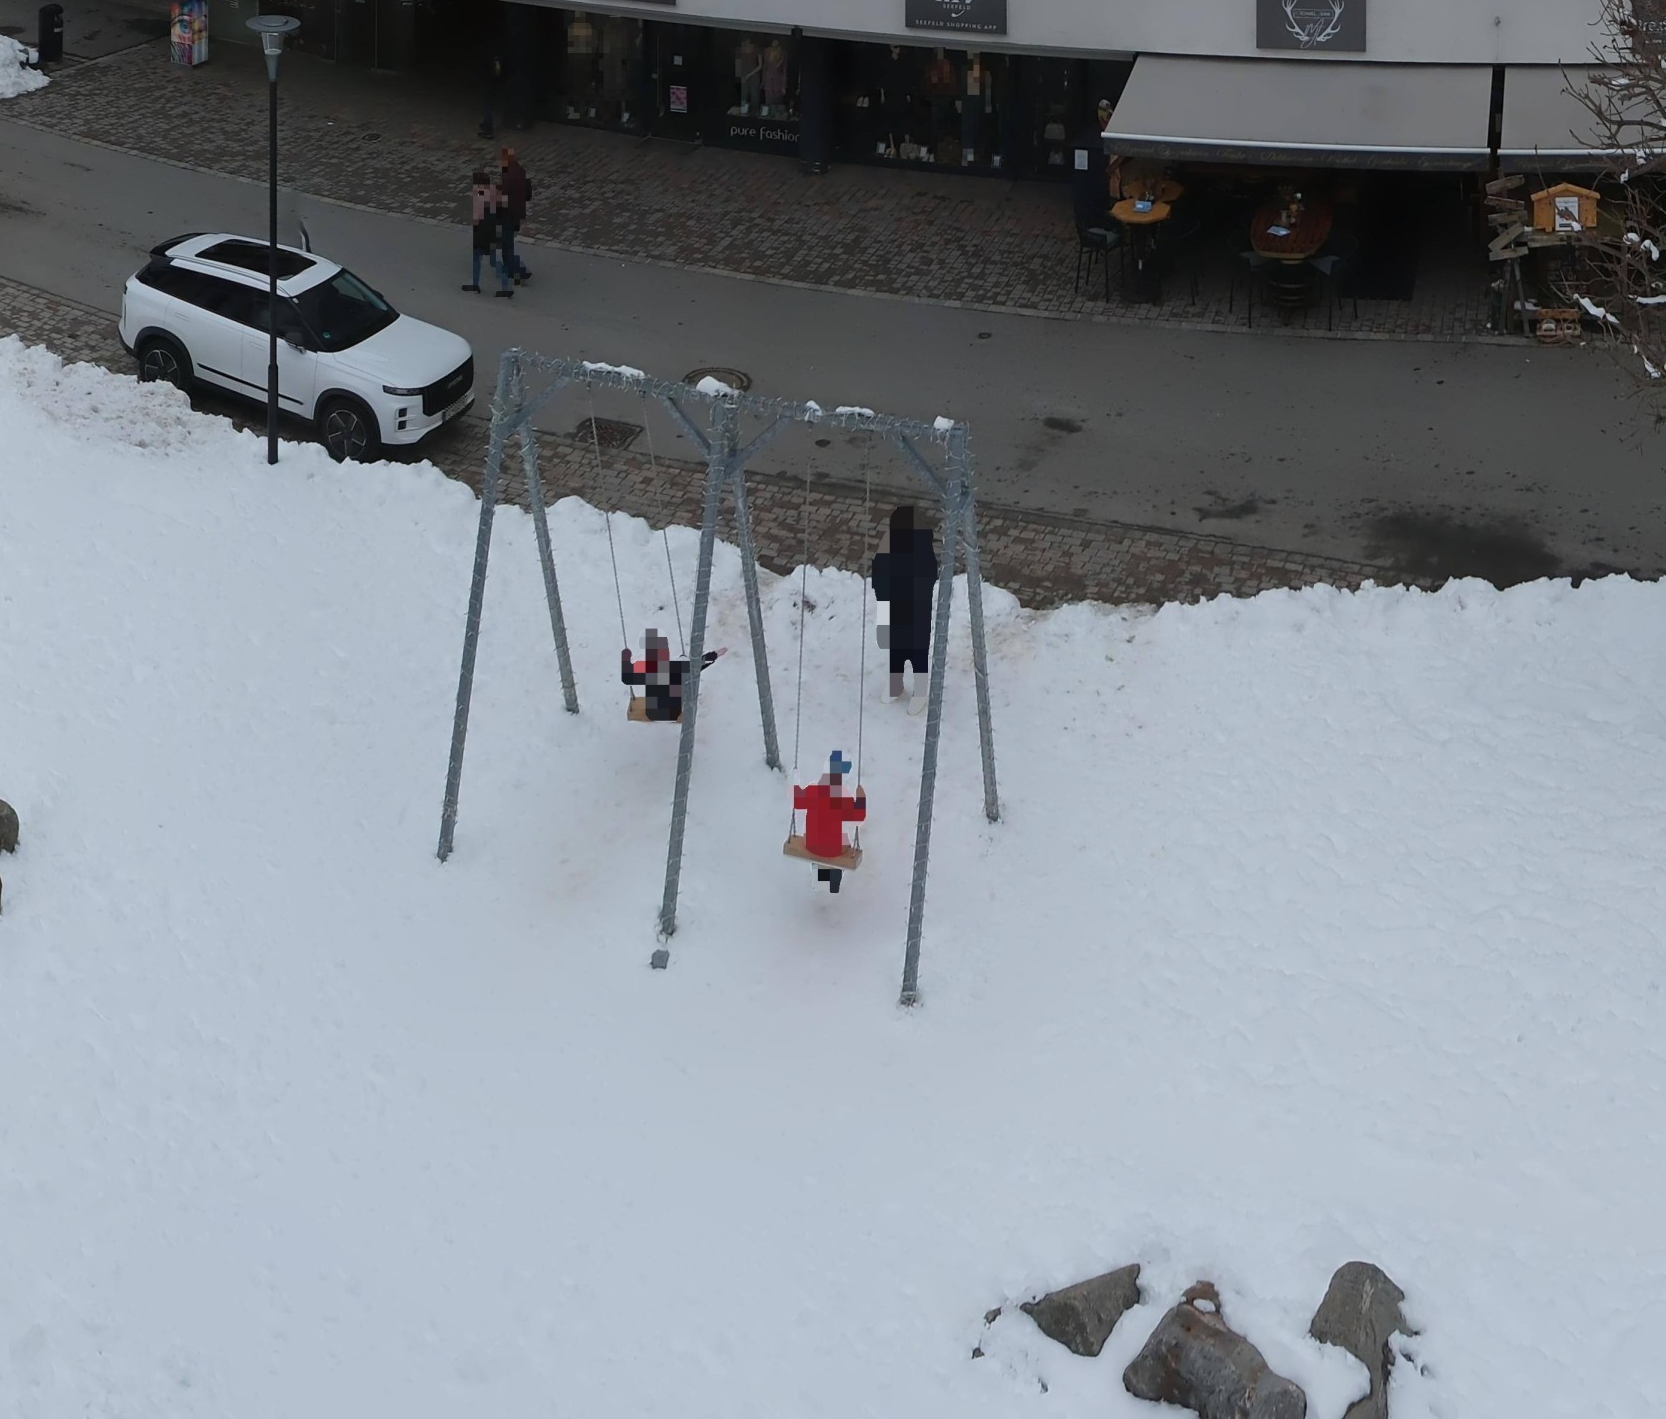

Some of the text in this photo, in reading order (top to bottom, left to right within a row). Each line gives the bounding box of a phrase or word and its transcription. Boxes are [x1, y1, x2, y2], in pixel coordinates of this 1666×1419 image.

[915, 19, 944, 27] SEEFELD
[946, 21, 982, 30] SHOPPING
[730, 126, 756, 137] pure
